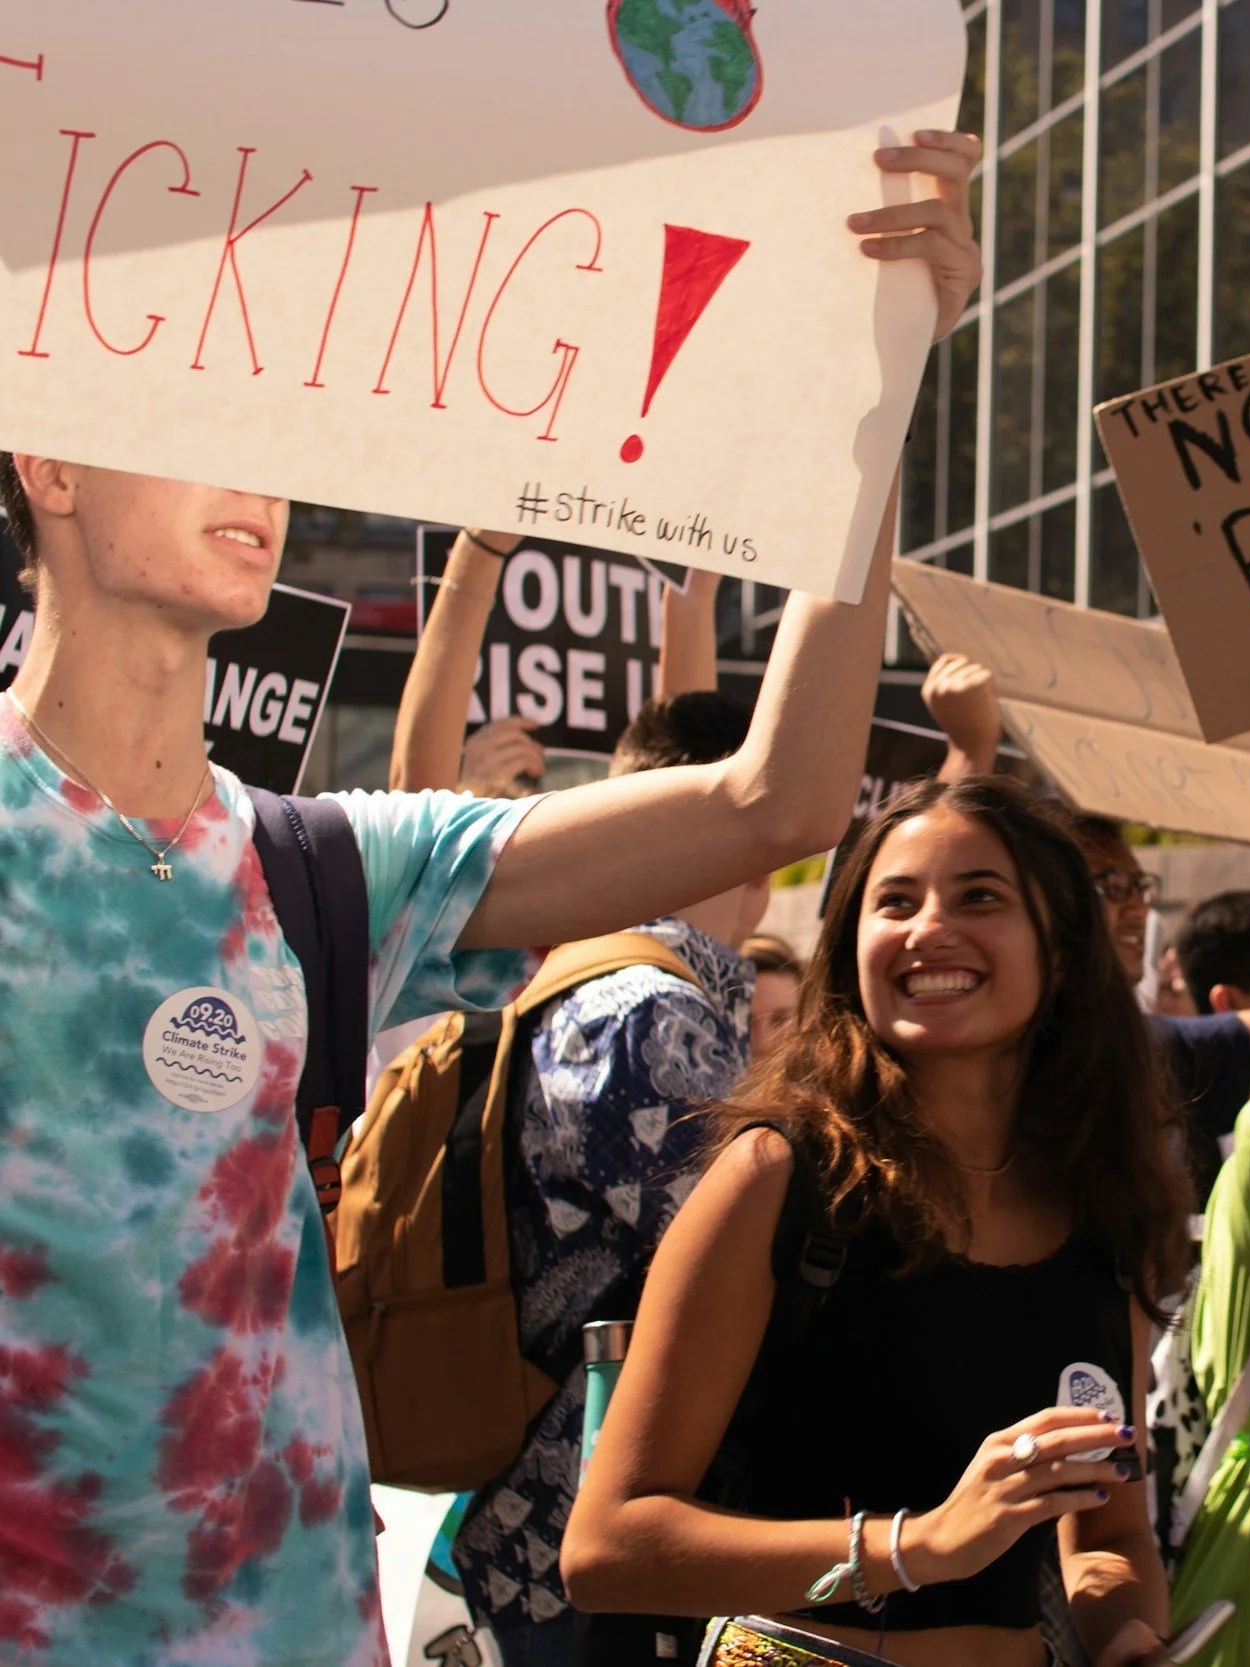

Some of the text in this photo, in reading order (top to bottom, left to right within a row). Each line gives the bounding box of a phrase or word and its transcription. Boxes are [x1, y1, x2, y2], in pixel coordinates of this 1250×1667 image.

[0, 53, 751, 465] ICKING!
[1110, 365, 1250, 438] THERE
[515, 481, 759, 563] #strike with us
[447, 548, 664, 651] OUT
[162, 1030, 247, 1061] Climate Strike
[190, 1003, 233, 1027] 09.20
[162, 1045, 242, 1072] We Are Rising Too
